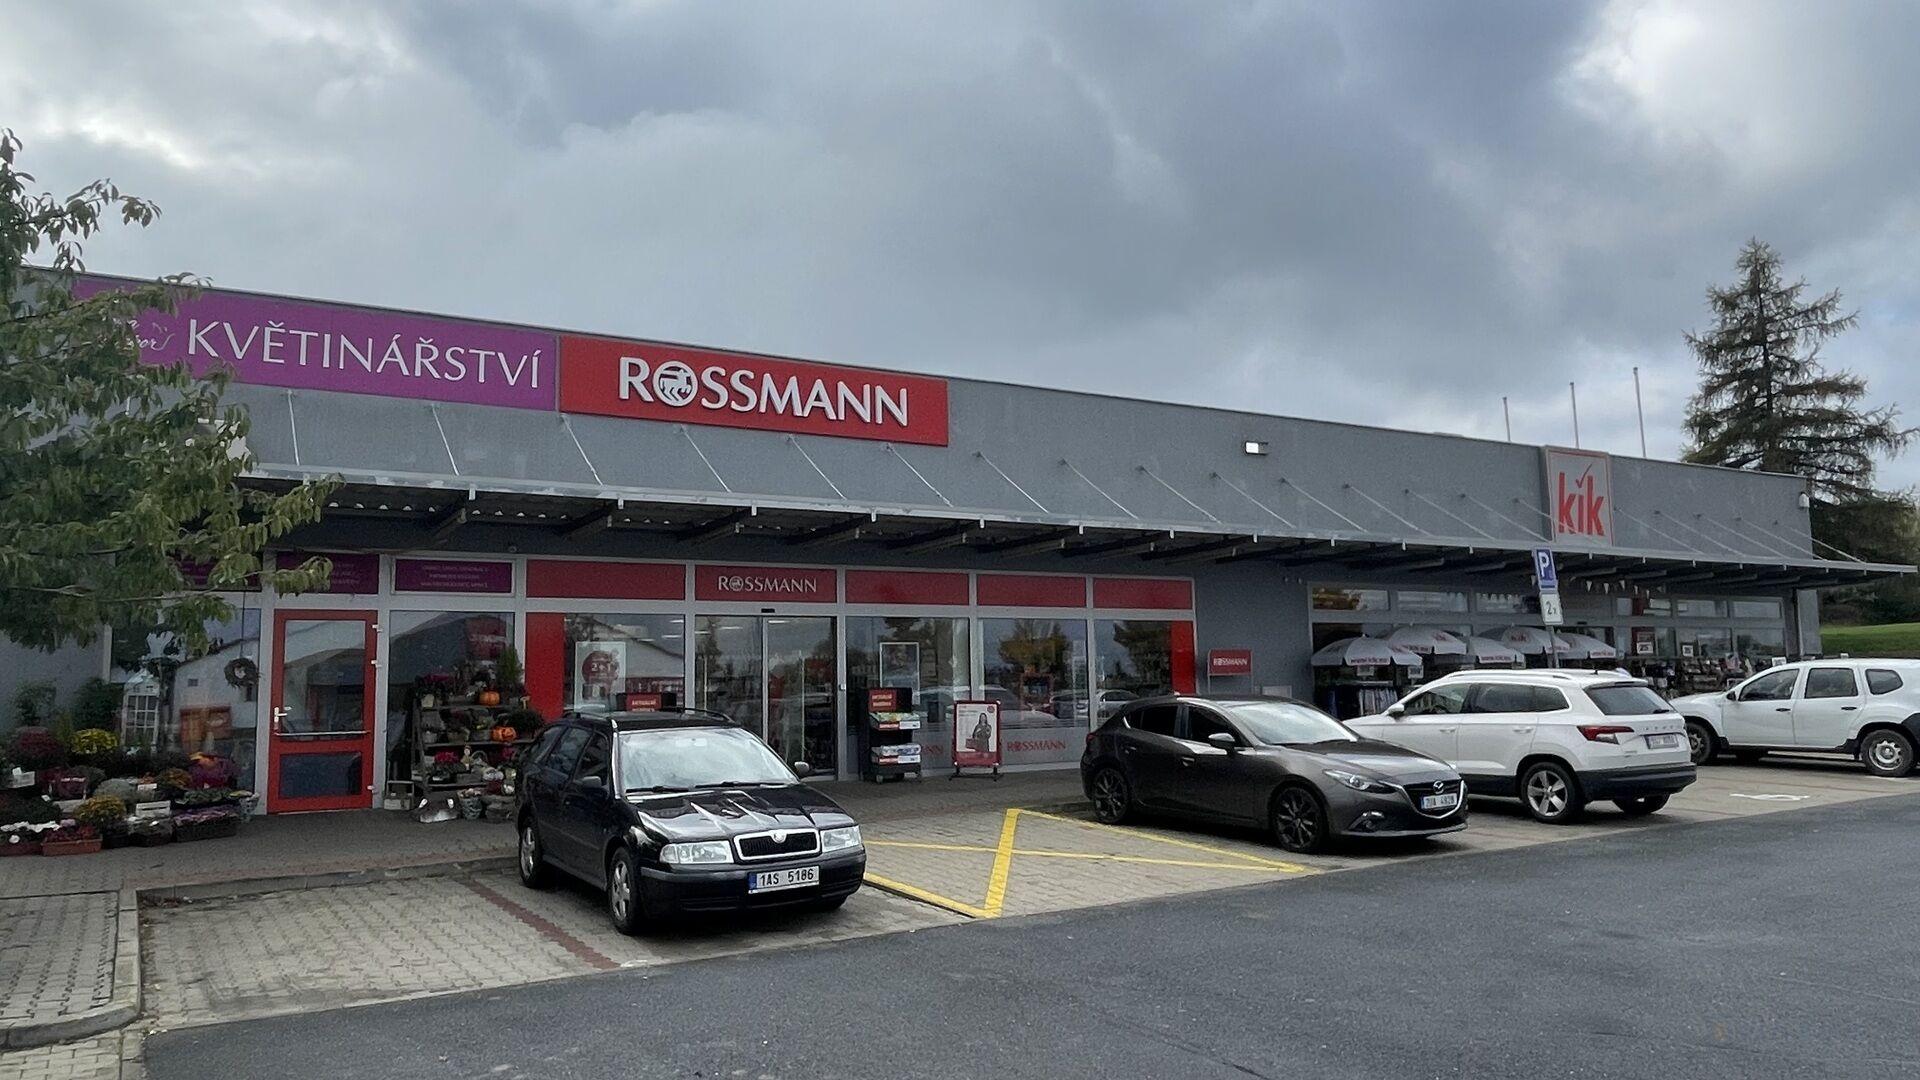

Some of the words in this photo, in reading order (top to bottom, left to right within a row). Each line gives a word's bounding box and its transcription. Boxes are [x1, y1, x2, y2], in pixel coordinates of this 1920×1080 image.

[187, 318, 542, 389] KVĚTINÁŘSTVÍ
[618, 356, 908, 427] ROSSMANN
[1557, 464, 1605, 536] kik
[1537, 551, 1550, 578] P
[717, 575, 818, 593] ROSSMANN
[1213, 657, 1248, 666] ROSSMANN
[1006, 740, 1067, 753] ROSSMANN
[760, 872, 780, 887] 1AS
[787, 868, 815, 883] 5186
